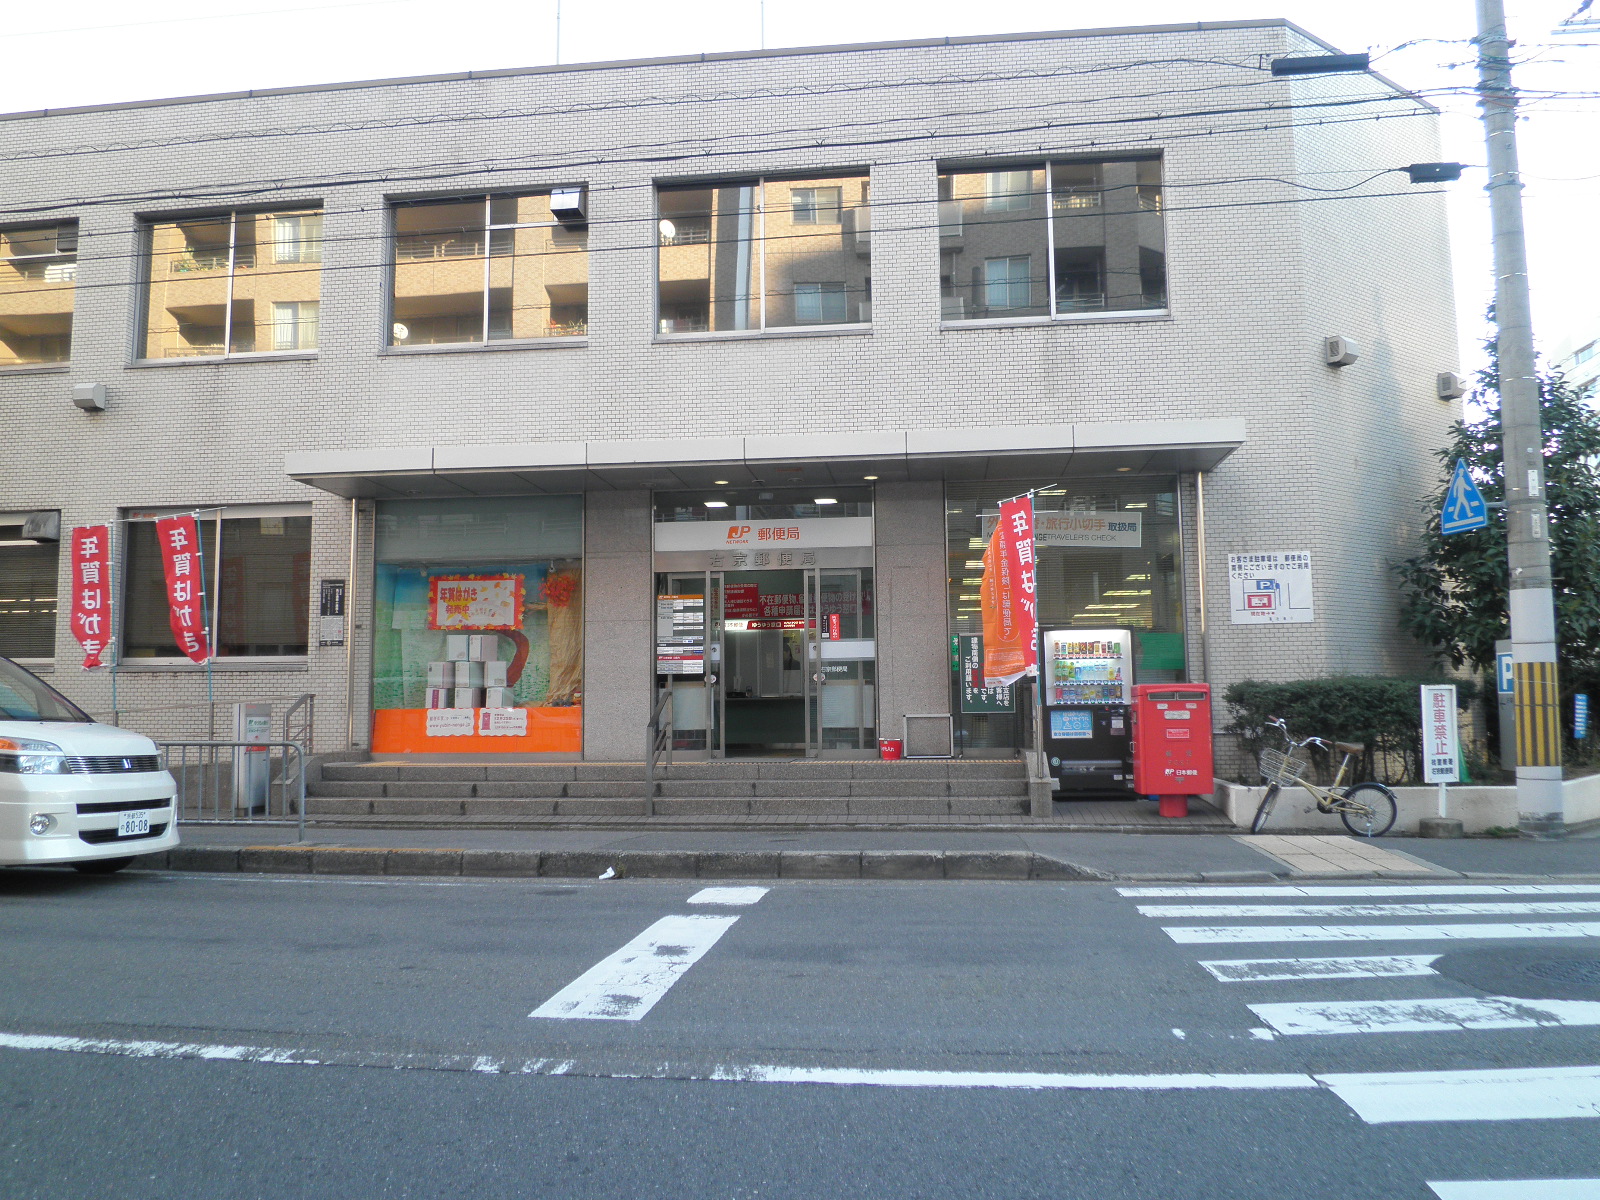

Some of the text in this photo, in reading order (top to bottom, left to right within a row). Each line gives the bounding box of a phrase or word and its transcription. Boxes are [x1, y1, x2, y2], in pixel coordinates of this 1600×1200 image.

[758, 527, 800, 541] 郵便局
[1107, 522, 1137, 532] 取扱局
[710, 552, 816, 568] 右京郵便局
[1284, 554, 1309, 562] 郵便局の
[1261, 581, 1271, 589] P
[440, 587, 478, 601] 年賀はがき
[446, 604, 470, 614] 発売中
[971, 637, 979, 694] 建物南側のを
[965, 656, 973, 704] ご利用願います。
[1501, 656, 1513, 690] P
[1433, 693, 1448, 755] 駐車禁止
[125, 820, 148, 833] 80-08
